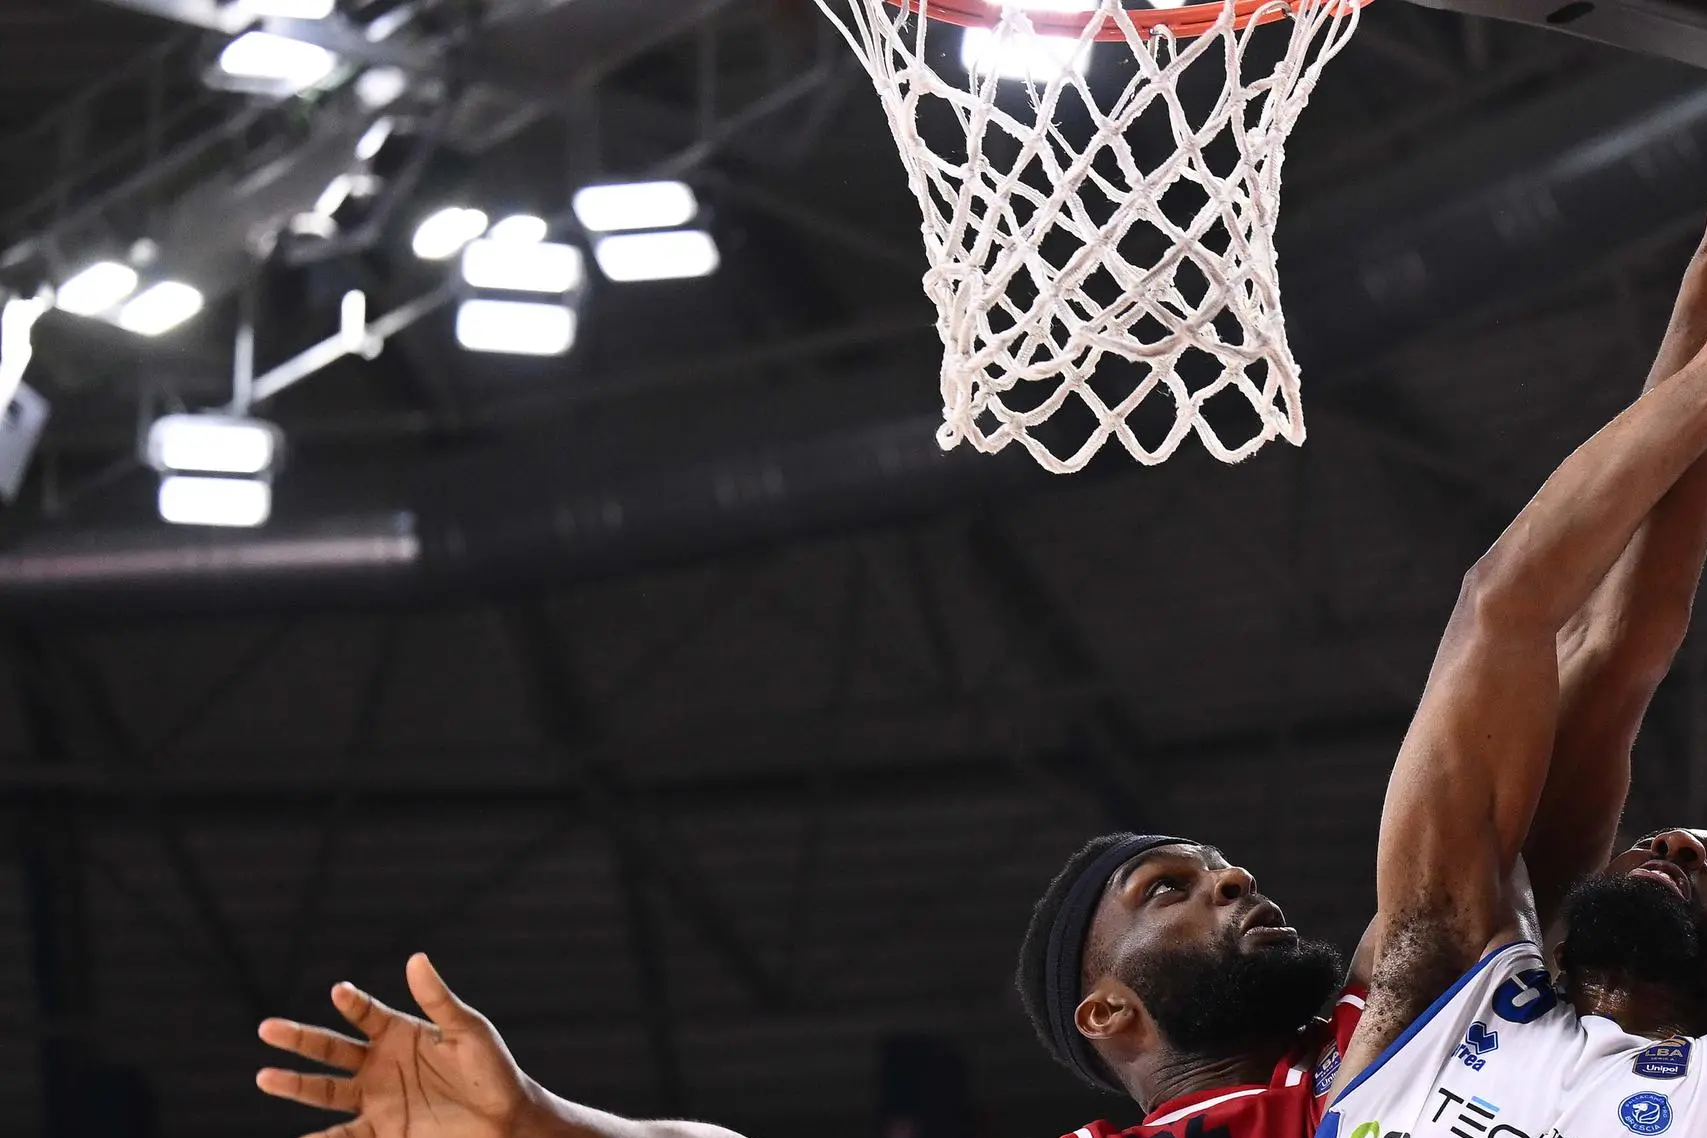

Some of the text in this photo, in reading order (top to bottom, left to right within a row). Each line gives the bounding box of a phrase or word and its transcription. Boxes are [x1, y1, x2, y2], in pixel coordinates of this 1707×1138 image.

[1645, 1047, 1683, 1058] LBA
[1646, 1064, 1679, 1074] Unipol
[1625, 1115, 1660, 1132] BRESCIA
